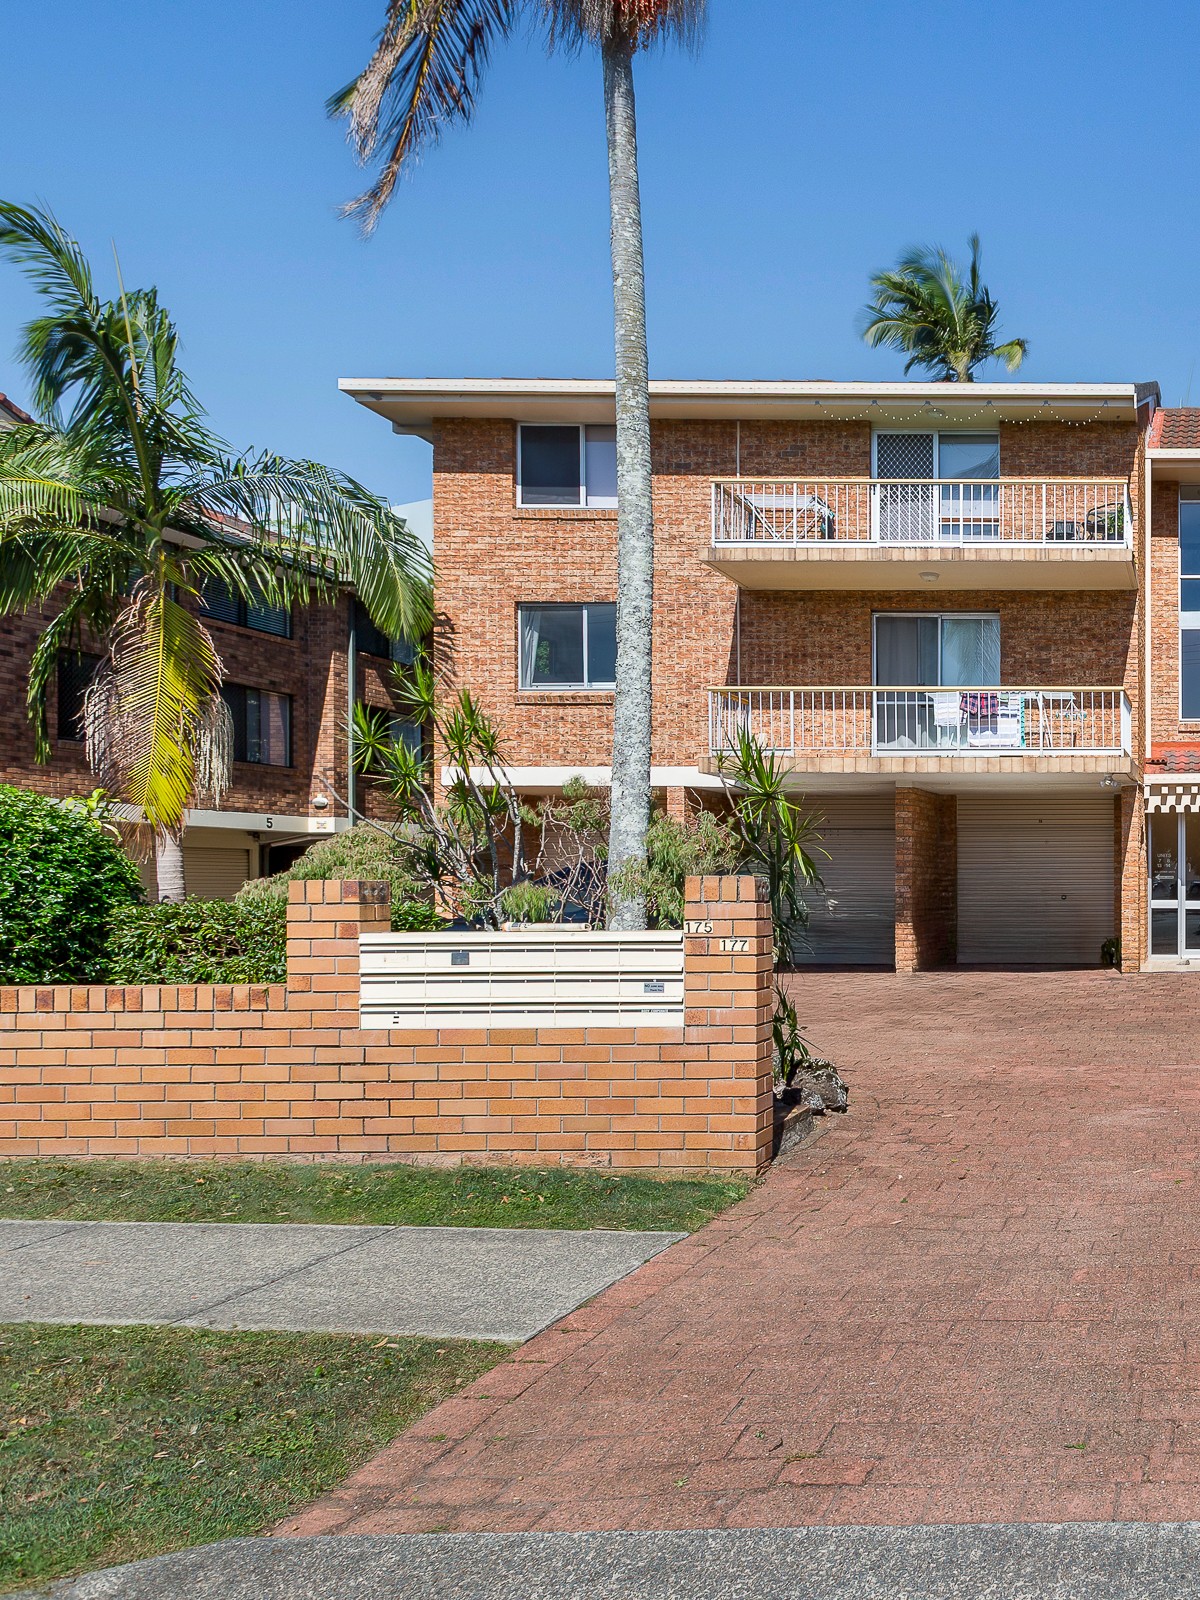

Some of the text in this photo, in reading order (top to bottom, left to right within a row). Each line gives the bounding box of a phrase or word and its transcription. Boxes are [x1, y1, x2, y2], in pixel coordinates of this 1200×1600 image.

[266, 817, 273, 828] 5
[685, 921, 713, 934] 175
[721, 939, 748, 952] 177
